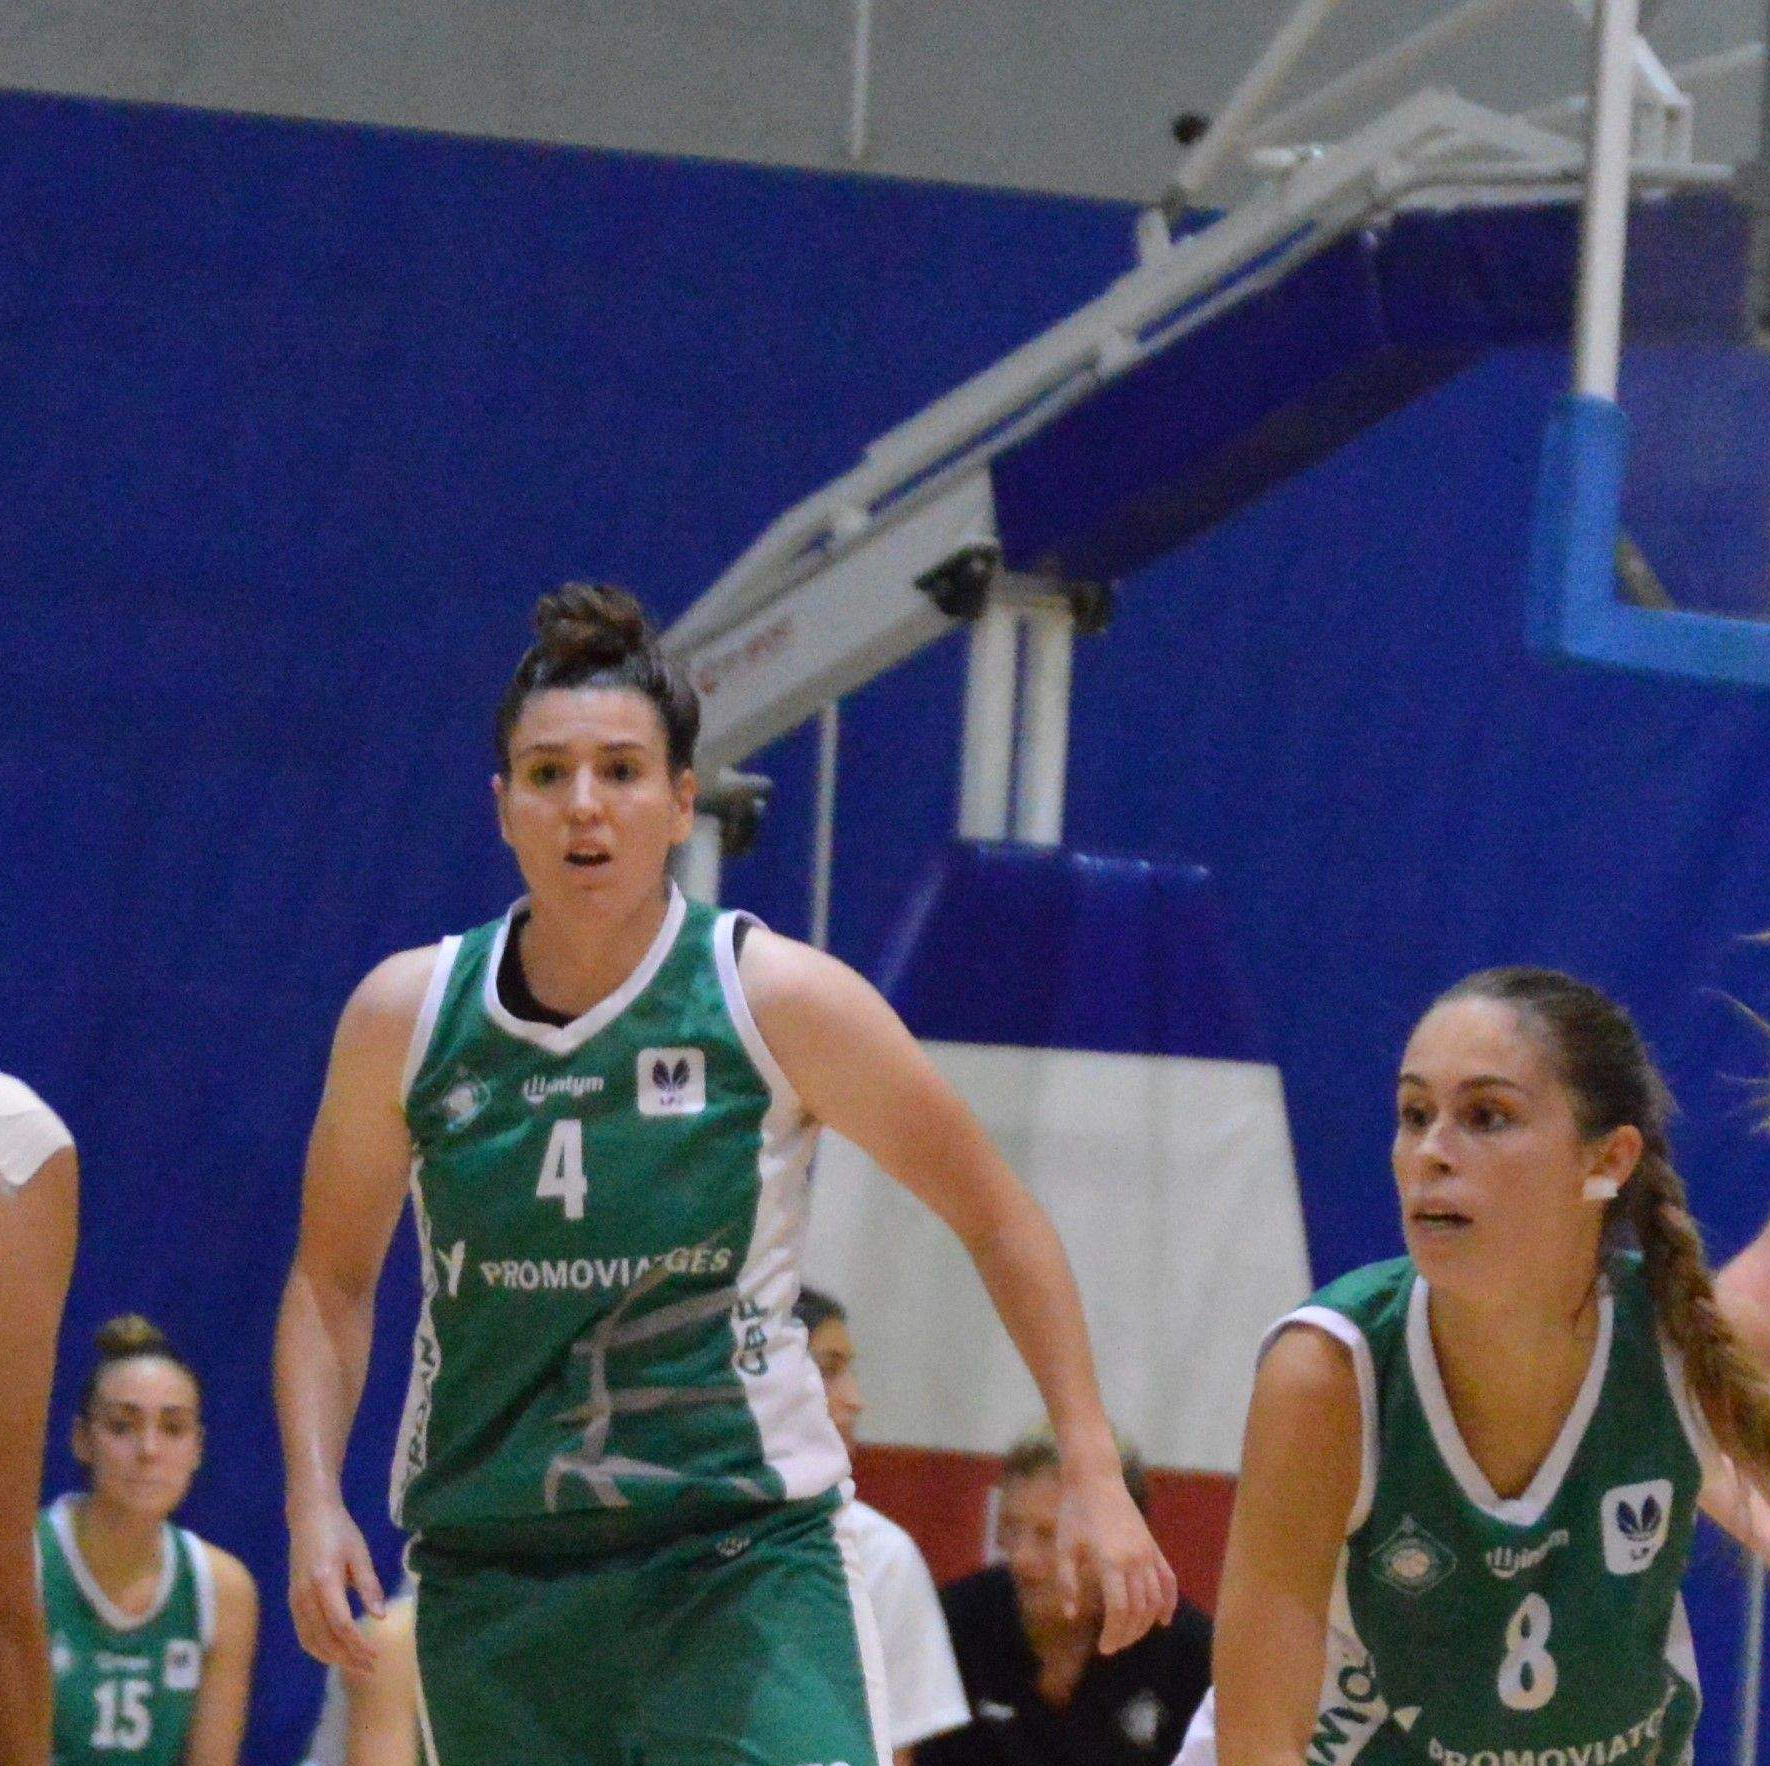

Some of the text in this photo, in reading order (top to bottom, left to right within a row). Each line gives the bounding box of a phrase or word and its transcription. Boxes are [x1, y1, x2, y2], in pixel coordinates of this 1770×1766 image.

[536, 1118, 588, 1221] 4
[1497, 1592, 1559, 1711] 8
[90, 1679, 153, 1751] 15
